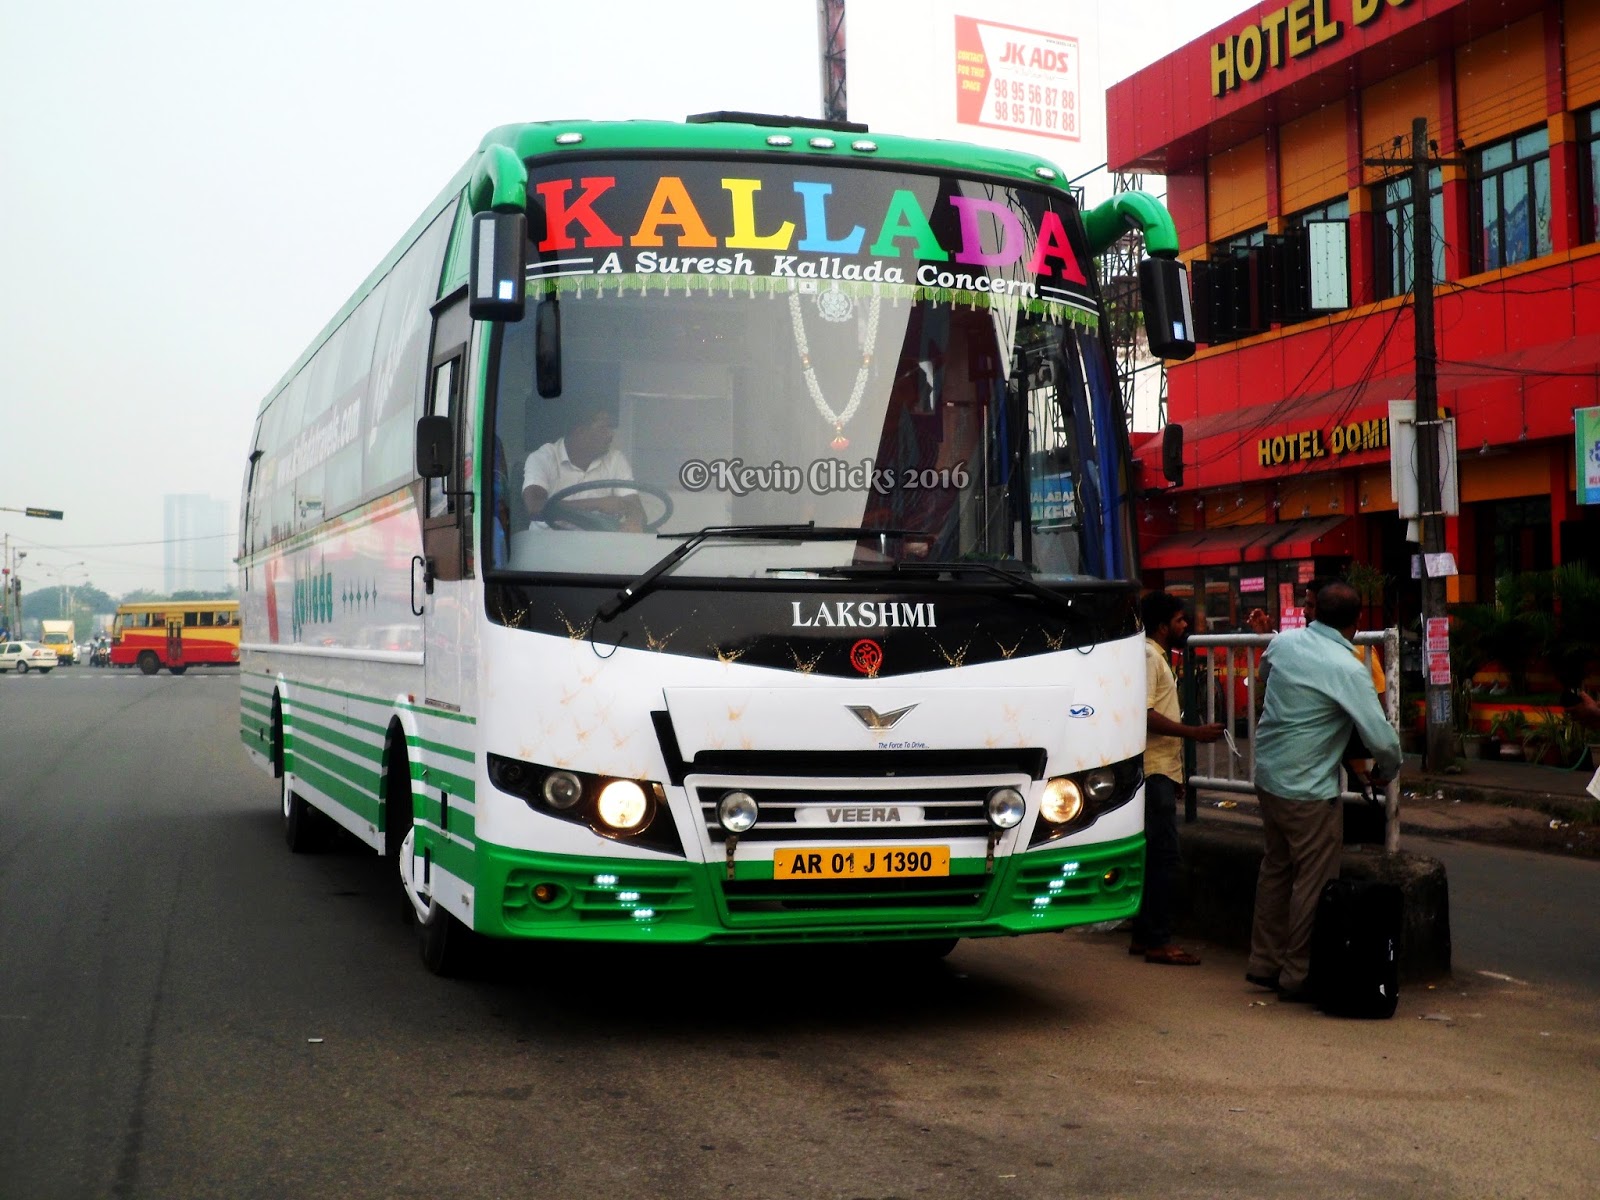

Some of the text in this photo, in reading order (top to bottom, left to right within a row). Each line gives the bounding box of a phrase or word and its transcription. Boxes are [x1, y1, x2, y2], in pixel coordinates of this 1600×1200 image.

[999, 42, 1026, 66] JK
[1029, 47, 1069, 73] ADS
[1210, 0, 1410, 97] HOTEL D
[994, 78, 1074, 110] 98 95 56 87 88
[995, 101, 1075, 132] 98 95 70 87 88
[536, 176, 1087, 286] KALLADA
[597, 251, 1039, 299] A Suresh Kallada Concern
[1258, 417, 1388, 466] HOTEL DOMI
[791, 601, 937, 628] LAKSHMI
[826, 807, 901, 823] VEERA
[791, 852, 932, 874] AR 01 J 1390
